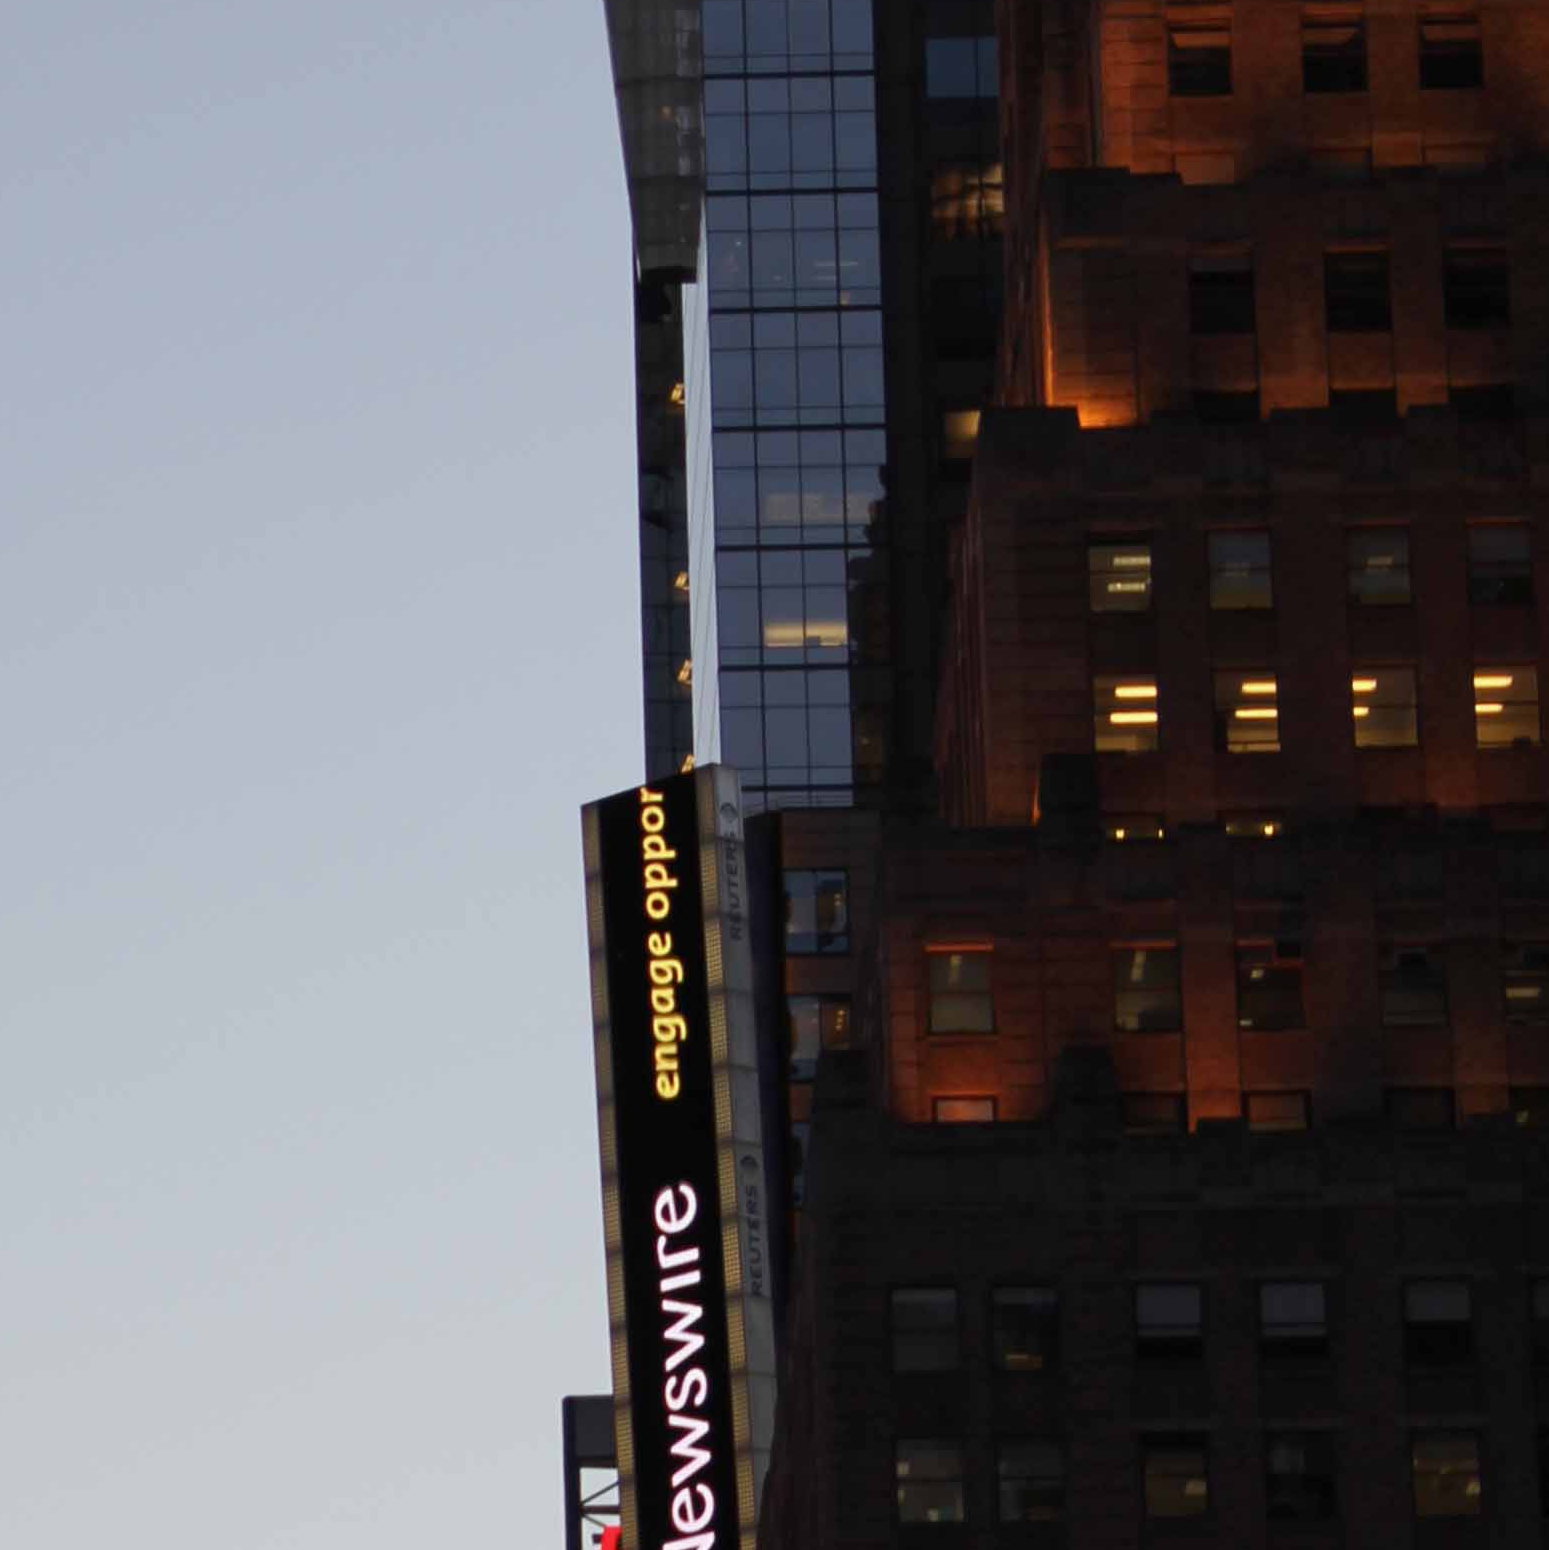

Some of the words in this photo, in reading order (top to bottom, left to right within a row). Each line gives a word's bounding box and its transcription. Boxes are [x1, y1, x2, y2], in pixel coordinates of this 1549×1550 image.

[724, 831, 745, 941] REUTERS
[647, 931, 688, 1100] engage
[746, 1183, 765, 1298] REUTERS
